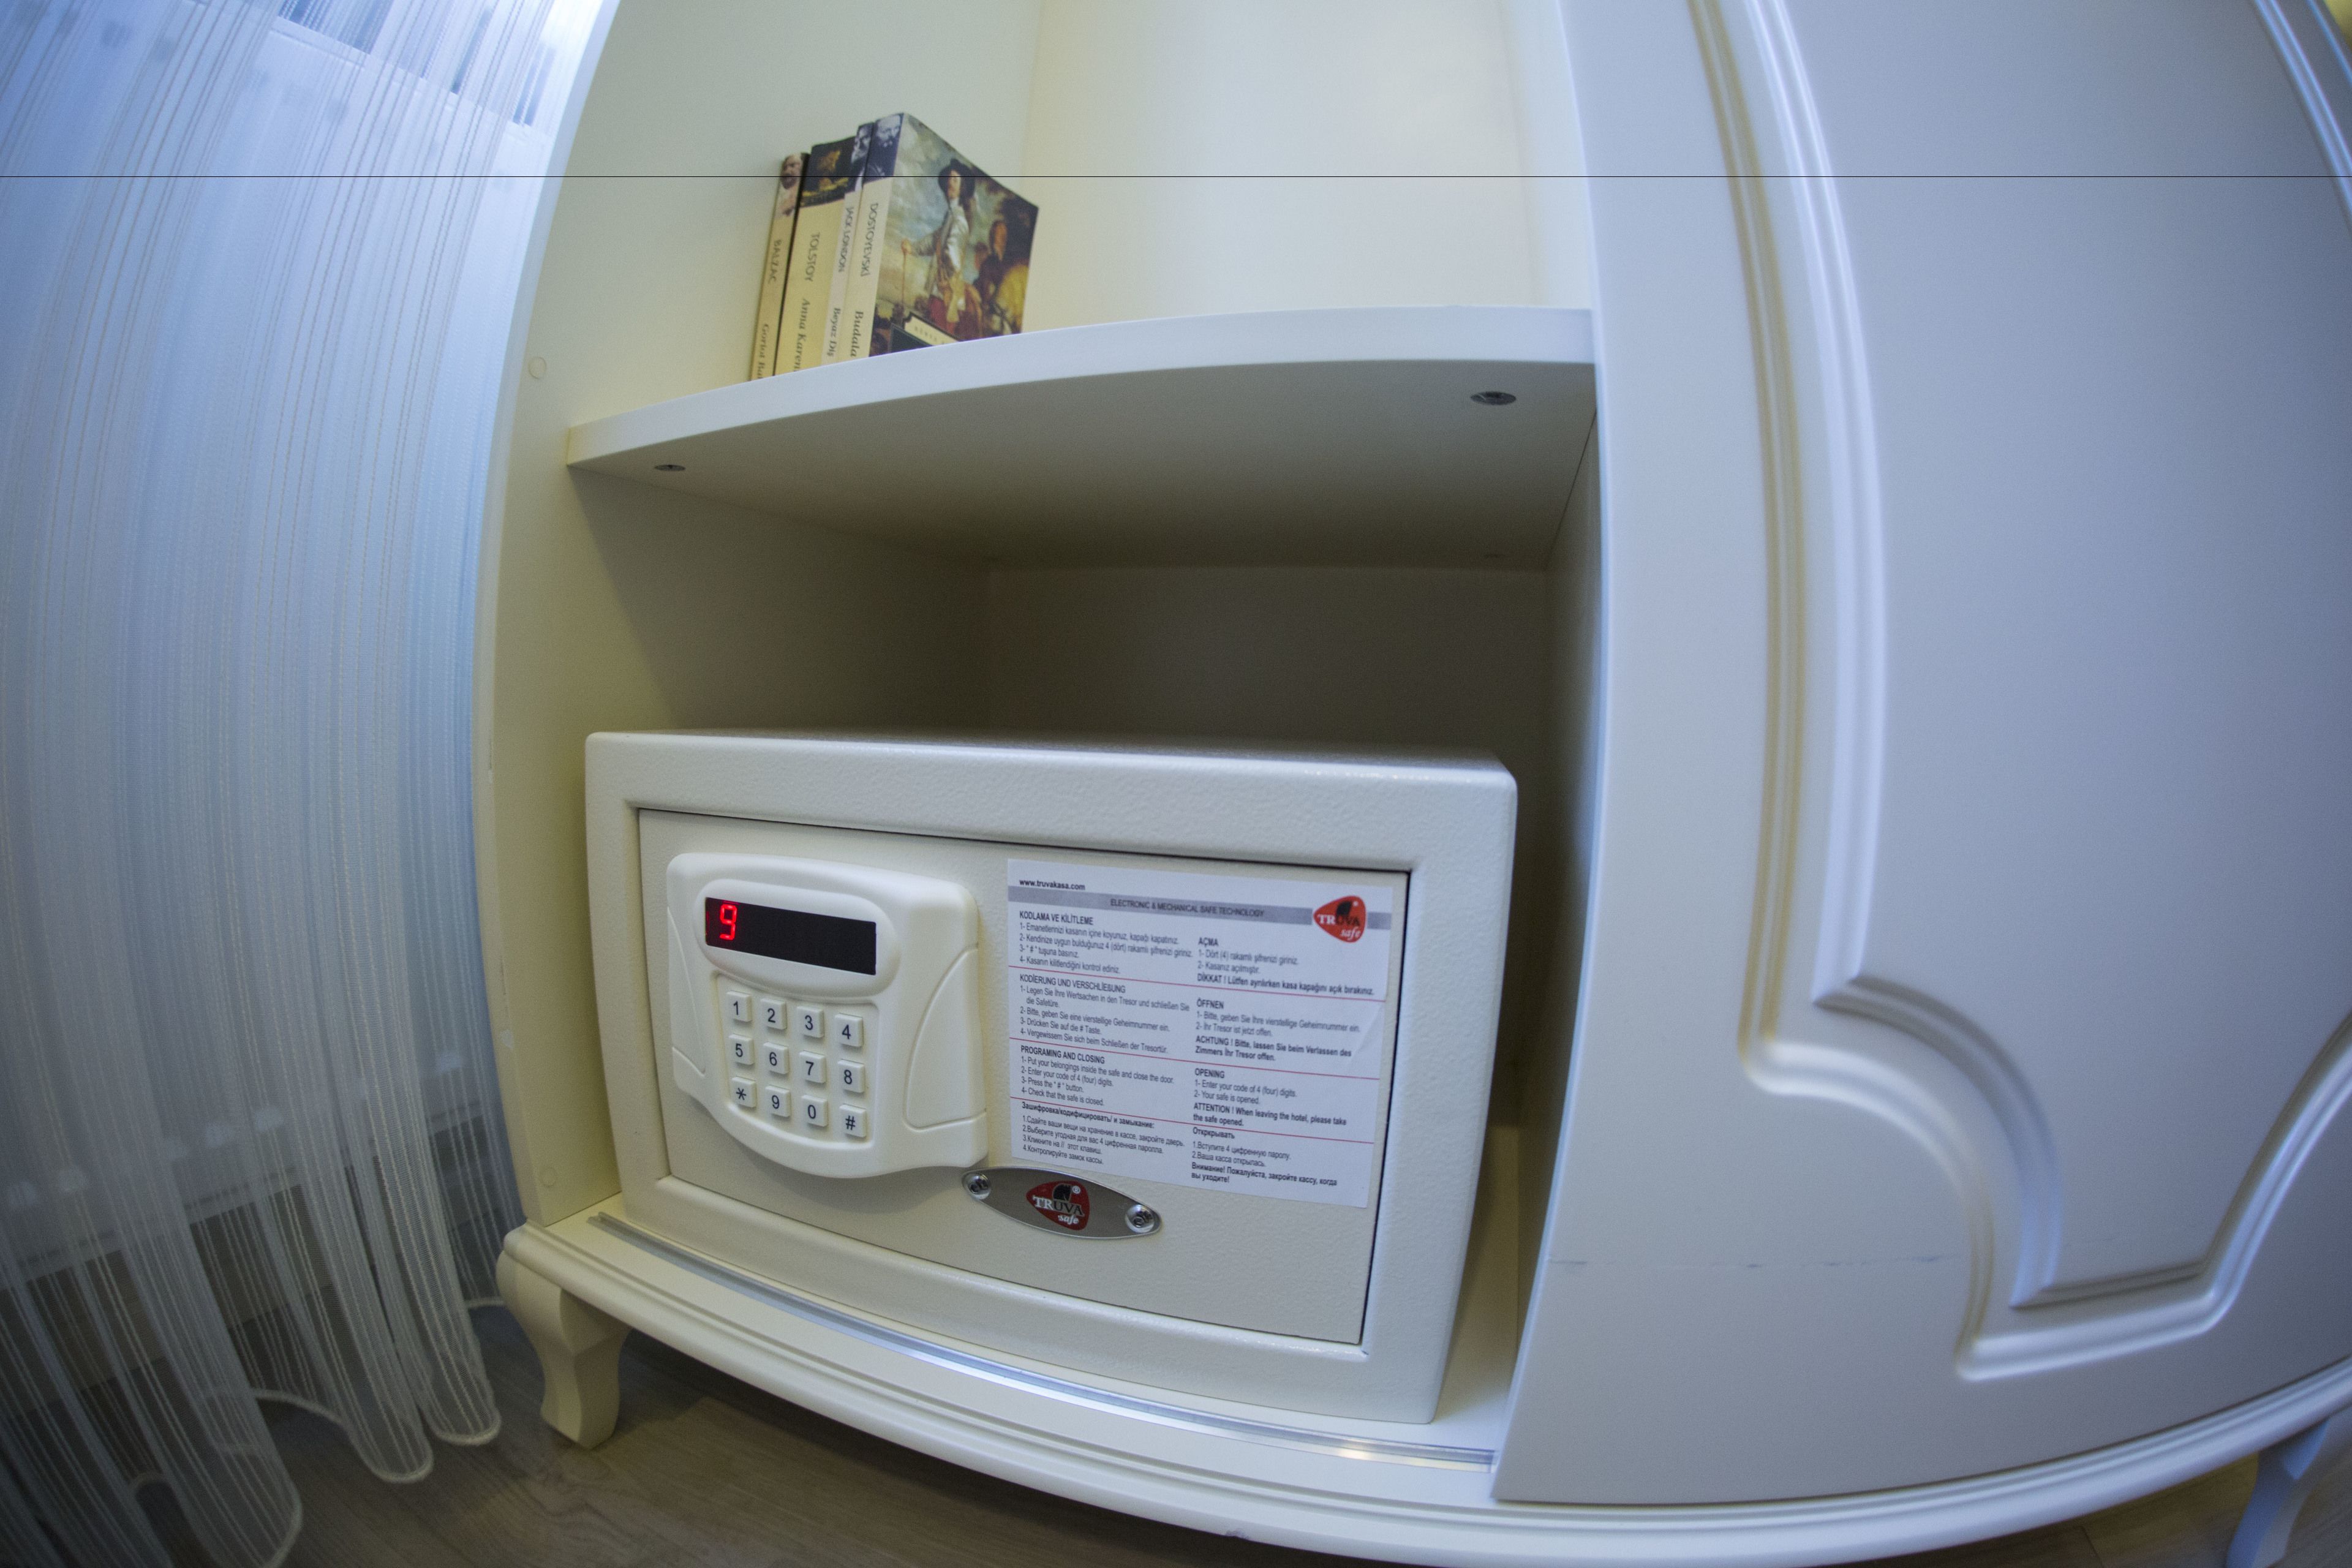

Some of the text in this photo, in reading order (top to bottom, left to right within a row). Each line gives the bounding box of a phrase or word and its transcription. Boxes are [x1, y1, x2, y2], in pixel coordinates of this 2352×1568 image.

[838, 206, 854, 273] JACK LONDON
[768, 239, 782, 285] BALZAC
[805, 232, 820, 282] TOLSTOY
[829, 307, 841, 338] Beyaz
[760, 323, 770, 358] Goriot
[794, 298, 810, 372] Anna Karen
[851, 311, 864, 358] Budala
[1019, 880, 1085, 889] www.truvakasa.com
[1110, 899, 1150, 909] ELECTRONIC
[1157, 903, 1198, 913] MECHANICAL
[719, 903, 738, 941] 9
[1020, 911, 1050, 921] KODLAMA
[1061, 914, 1093, 925] KİLİTLEME
[1340, 926, 1361, 941] safe
[1199, 937, 1218, 947] AÇMA
[1058, 979, 1071, 987] UND
[1027, 986, 1043, 996] Legen
[1066, 990, 1099, 1001] Wertsachen
[1119, 996, 1137, 1006] Tresor
[1180, 1003, 1189, 1011] Sie
[733, 1001, 739, 1015] 1
[767, 1008, 775, 1023] 2
[1041, 1010, 1058, 1019] geben
[1060, 1011, 1068, 1020] Sie
[805, 1015, 813, 1031] 3
[1027, 1017, 1049, 1027] Drücken
[1050, 1020, 1059, 1029] Sie
[1241, 1014, 1251, 1023] Sie
[842, 1025, 851, 1039] 4
[1213, 1023, 1232, 1033] Tresor
[1196, 1036, 1229, 1046] ACHTUNG
[736, 1043, 743, 1057] 5
[1021, 1045, 1061, 1058] PROGRAMING
[1077, 1054, 1105, 1064] CLOSING
[1196, 1046, 1223, 1055] Zimmers
[1235, 1050, 1256, 1059] Tresor
[769, 1052, 777, 1066] 6
[1028, 1057, 1037, 1065] Put
[1050, 1060, 1079, 1072] belongings
[805, 1061, 814, 1076] 7
[1195, 1068, 1224, 1079] OPENING
[844, 1069, 853, 1085] 8
[1028, 1066, 1042, 1076] Enter
[1056, 1071, 1069, 1080] code
[1070, 1072, 1077, 1081] of
[1082, 1075, 1098, 1085] (four)
[1098, 1077, 1113, 1087] digits.
[1202, 1079, 1218, 1088] Enter
[1028, 1077, 1043, 1087] Press
[1066, 1084, 1084, 1092] button.
[1028, 1087, 1044, 1096] Check
[772, 1095, 780, 1109] 9
[807, 1104, 816, 1119] 0
[1194, 1102, 1230, 1113] ATTENTION
[1255, 1110, 1278, 1121] leaving
[845, 1115, 855, 1130] #
[1192, 1162, 1225, 1173] Внимание!
[1032, 1195, 1085, 1217] TRUVA
[1058, 1215, 1079, 1225] safe
